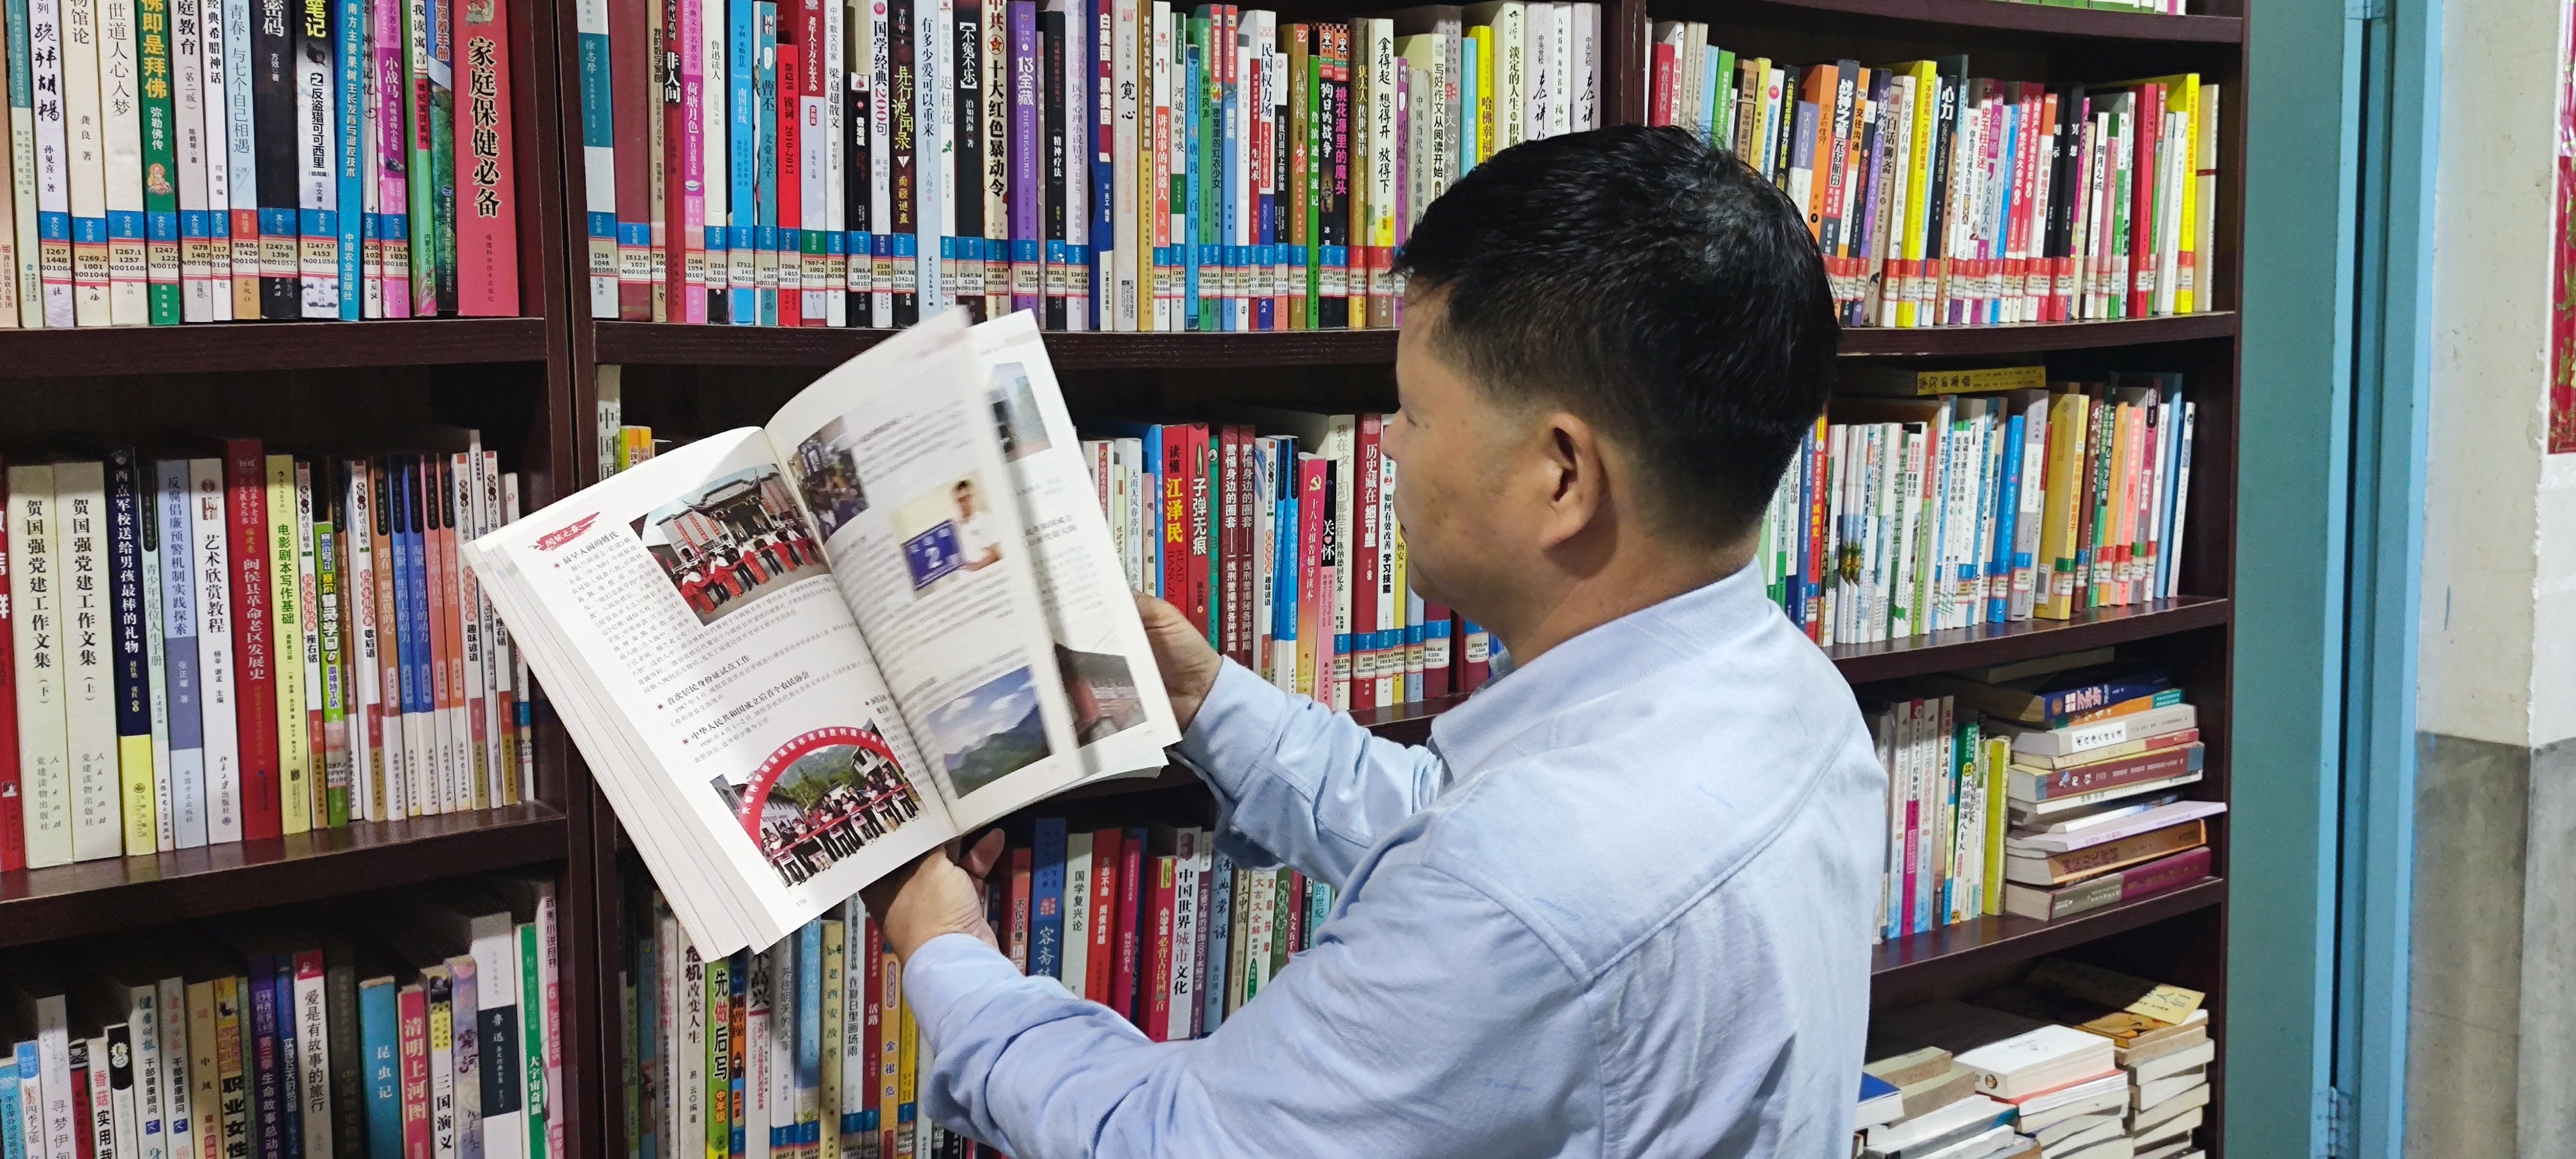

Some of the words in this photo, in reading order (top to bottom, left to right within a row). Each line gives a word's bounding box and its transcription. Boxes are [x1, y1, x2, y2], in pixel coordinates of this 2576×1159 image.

[106, 3, 131, 116] 世道人心入梦
[412, 3, 428, 67] 我读寓言
[585, 40, 596, 74] 徐志摩
[711, 40, 720, 80] 鲁迅读人
[808, 16, 818, 91] 老年人十万个怎么办
[829, 6, 838, 62] 中华散文百家
[1378, 36, 1392, 86] 拿得起
[384, 56, 400, 99] 小战马
[665, 51, 681, 103] 非人间
[687, 82, 699, 135] 荷塘月色
[738, 87, 747, 125] 南回归线
[829, 67, 840, 128] 梁启超散文
[873, 21, 888, 136] 国学经典200句
[891, 66, 913, 151] 异行诡闻录
[921, 17, 934, 137] 有多少爱可以重来
[940, 76, 953, 125] 迟桂花
[1017, 56, 1034, 106] 13宝藏
[1202, 75, 1210, 119] 柳林风声
[1260, 43, 1273, 117] 民国权力场
[1940, 86, 1955, 120] 心力
[150, 107, 164, 151] 弥勒佛传
[467, 36, 501, 219] 家庭保健必备
[988, 60, 1005, 197] 十大红色暴动令
[1174, 86, 1184, 153] 河边的呼唤
[1212, 108, 1221, 189] 密室里的红衣少女
[1321, 83, 1333, 158] 狗日的战争
[1335, 86, 1347, 195] 桃花源里的魔头
[1433, 63, 1444, 178] 写好作文从阅读开始
[1851, 108, 1864, 152] 交往沟通
[1883, 117, 1896, 174] 白话聊斋
[1900, 99, 1911, 155] 容忍与自由
[764, 133, 773, 178] 文豪天子
[1053, 136, 1062, 178] 精神疗法
[1156, 114, 1168, 201] 讲故事的机器人
[1189, 141, 1199, 231] 唐诗三百首
[1251, 140, 1259, 181] 一生何求
[1310, 112, 1318, 206] 鲁滨逊漂流记
[1378, 147, 1392, 195] 放得下
[343, 232, 354, 301] 中国农业出版社
[1168, 444, 1181, 473] 读懂
[1130, 468, 1139, 537] 无雨无风春亦归
[1166, 477, 1183, 543] 江泽民
[1192, 477, 1208, 555] 子弹无痕
[1364, 443, 1378, 548] 历史藏在细节里
[1383, 493, 1393, 549] 如何有效改善
[116, 469, 139, 654] 西点军校送给男孩最棒的礼物
[168, 476, 187, 637] 反腐倡廉预警机制实践探索
[277, 523, 294, 625] 电影剧本写作基础
[1305, 499, 1318, 602] 十八大报告辅导读本
[1336, 542, 1344, 593] 陈纳德回忆录
[1382, 553, 1392, 594] 学习技能
[26, 499, 51, 669] 贺国强党建工作文集
[72, 499, 97, 667] 贺国强党建工作文集
[145, 563, 164, 667] 青少年定位人生手册
[202, 534, 225, 634] 艺术欣赏教程
[243, 558, 266, 681] 闽侯县革命老区发展史
[306, 635, 318, 663] 座右铭
[466, 623, 478, 662] 趣味谚语
[667, 655, 751, 705] 首次居民身份证试点工作
[37, 755, 51, 831] 党建读物出版社
[82, 752, 94, 828] 党建读物出版社
[1014, 899, 1026, 943] 不仅仅是
[1072, 870, 1085, 932] 国学复兴论
[1172, 868, 1193, 995] 中国世界城市文化
[1250, 877, 1264, 935] 文言文全解
[685, 946, 703, 1045] 危机改变人生
[714, 968, 730, 1081] 先做后写
[868, 1003, 879, 1025] 活路
[304, 989, 325, 1114] 爱是有故事的旅行
[377, 1045, 392, 1099] 昆虫记
[405, 1018, 427, 1122] 清明上河图
[884, 1039, 896, 1097] 金银岛
[145, 1058, 158, 1115] 干部健康顾问
[172, 1057, 185, 1113] 干部健康顾问
[435, 1074, 453, 1150] 三国演义
[528, 1056, 542, 1116] 大宇宙奇旅
[714, 1090, 726, 1124] 中年级
